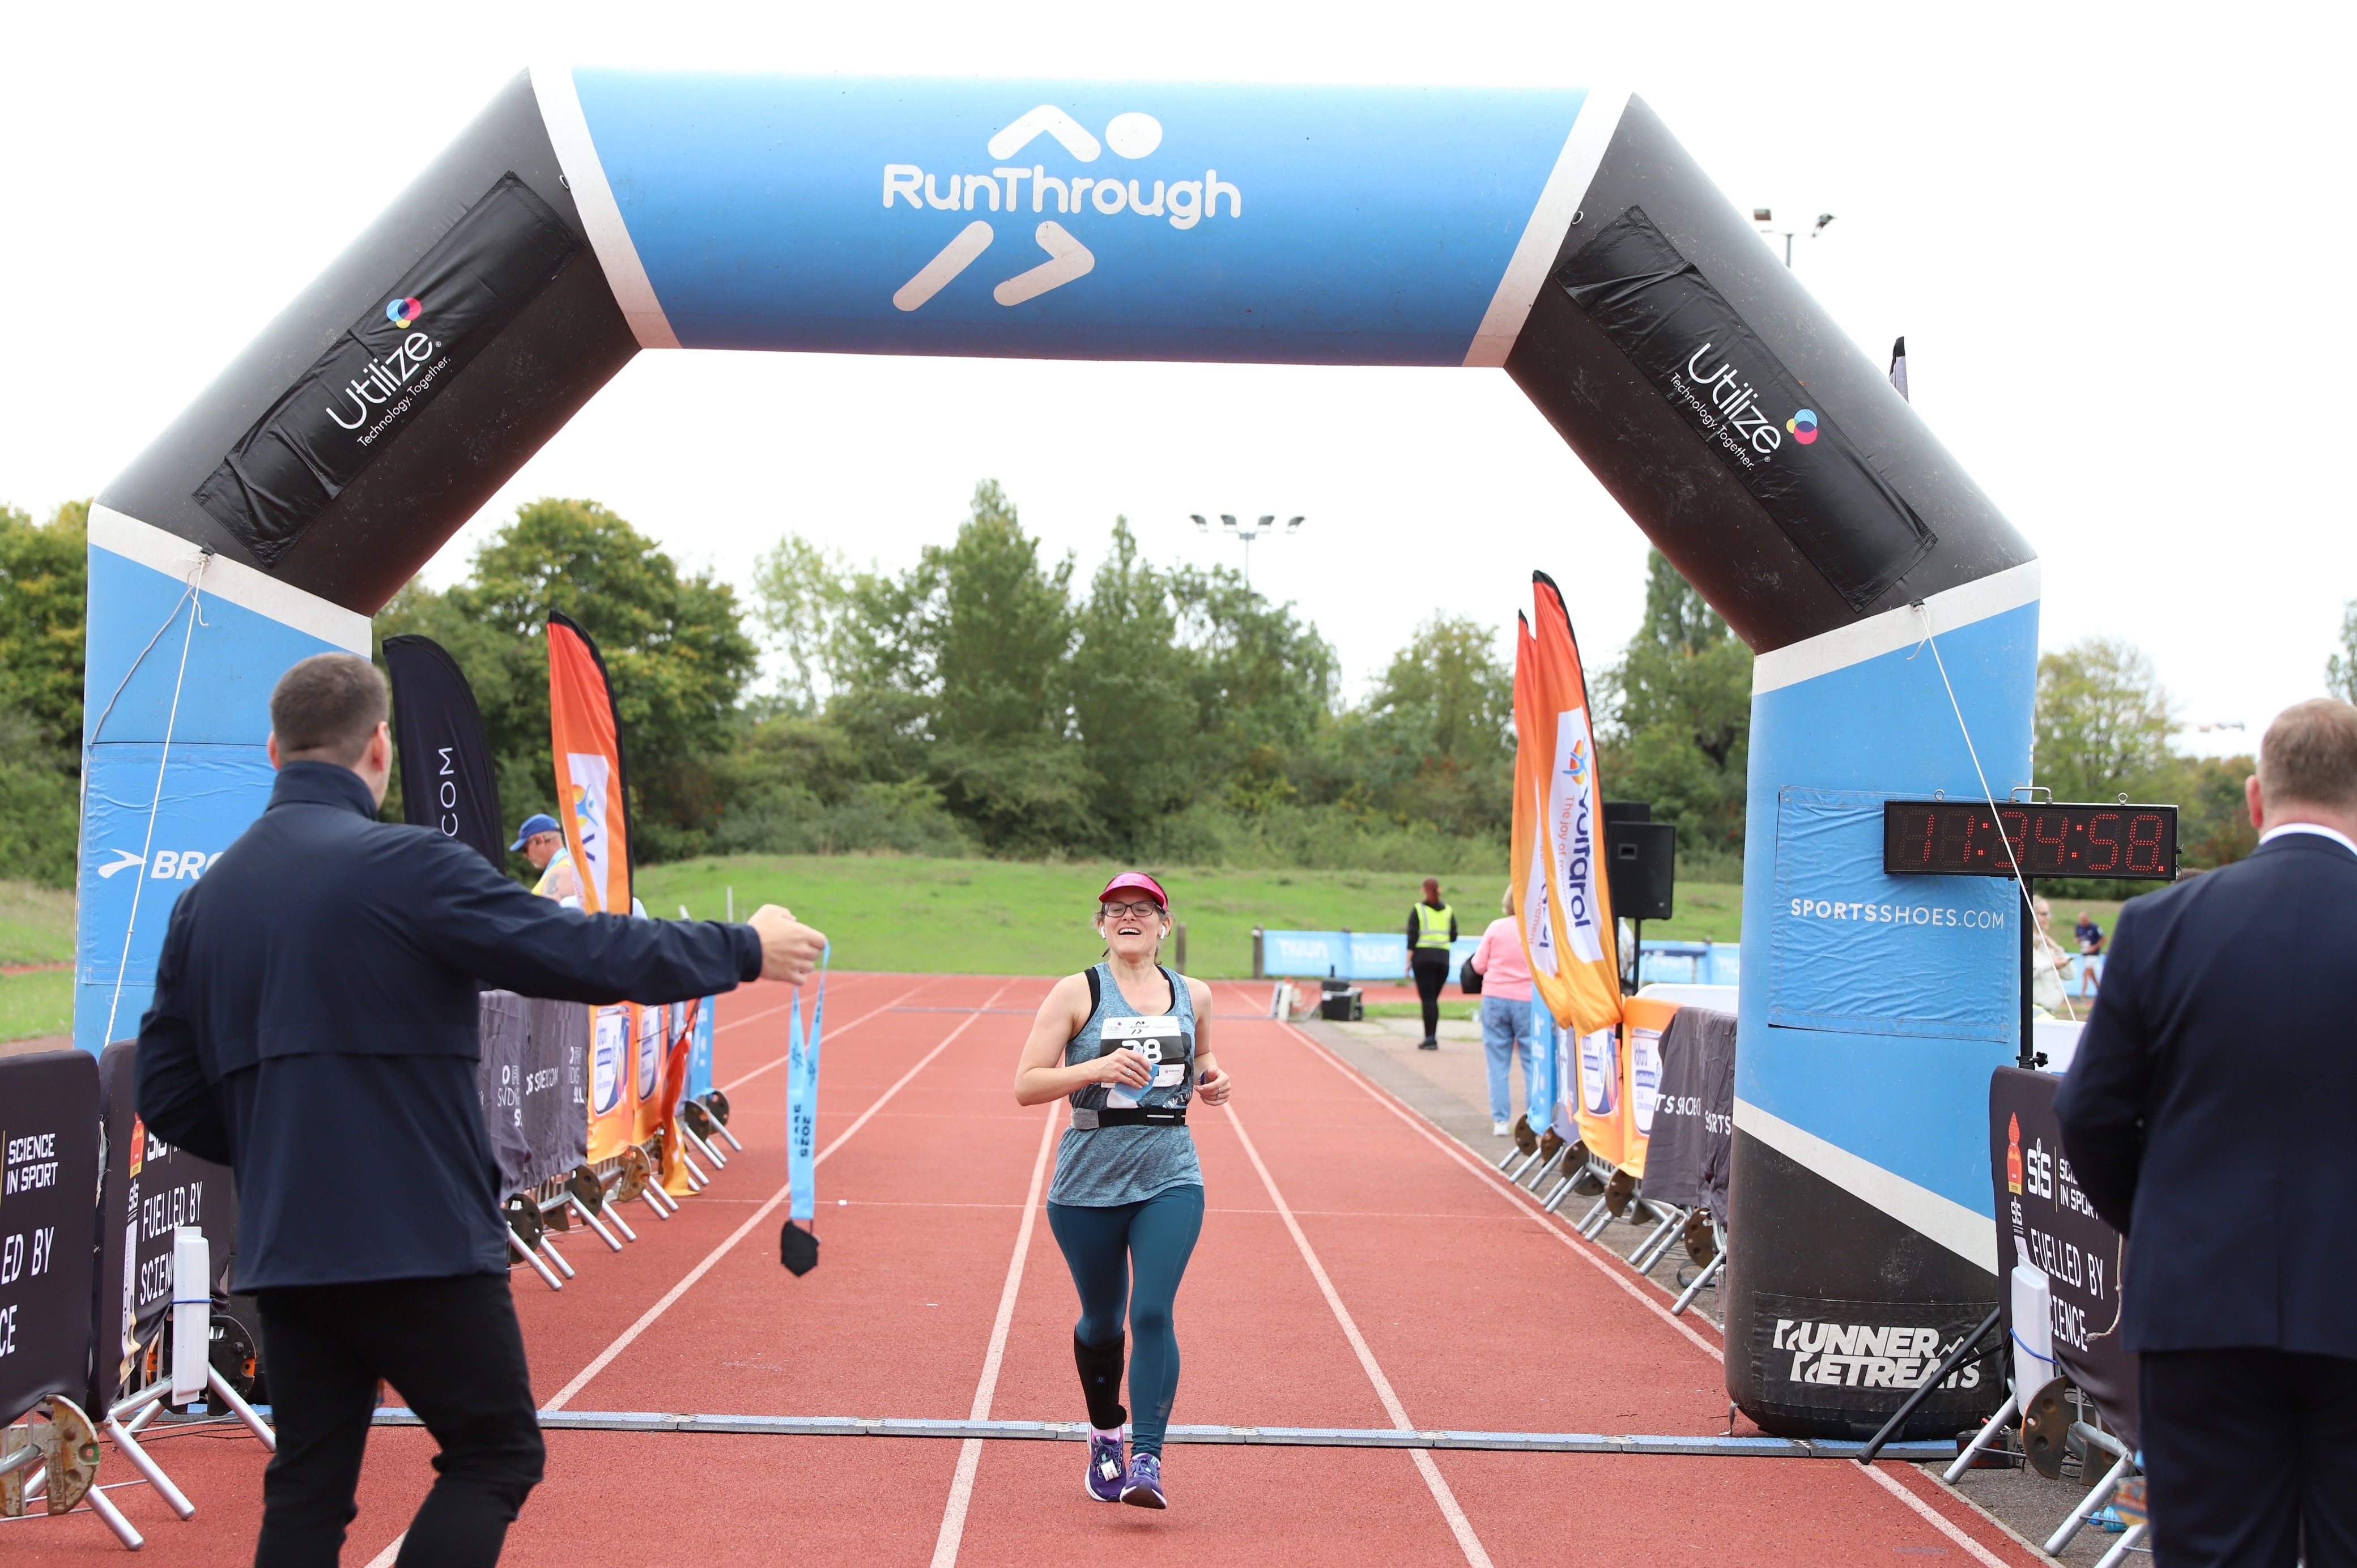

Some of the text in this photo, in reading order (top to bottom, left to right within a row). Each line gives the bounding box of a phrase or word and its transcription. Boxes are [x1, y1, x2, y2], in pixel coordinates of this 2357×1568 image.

[883, 164, 1241, 230] RunThrough
[325, 332, 433, 429] Utilize
[356, 356, 451, 447] Technology. Together.
[1688, 342, 1781, 454] Utilize
[1670, 372, 1754, 471] Technology. Together.
[439, 747, 458, 837] COM
[1562, 795, 1575, 819] The
[1558, 820, 1572, 841] joy
[1559, 842, 1567, 856] of
[1790, 898, 2004, 930] SPORTSSHOES.COM
[8, 1133, 56, 1165] SCIENCE
[6, 1162, 58, 1195] IN SPORT
[2060, 1183, 2069, 1207] IN
[142, 1181, 203, 1242] FUELLED BY
[31, 1226, 55, 1276] BY
[140, 1251, 174, 1306] SCIEN
[2031, 1228, 2104, 1301] FUELLED BY
[1772, 1319, 1939, 1358] RUNNER
[2050, 1294, 2088, 1353] IENCE
